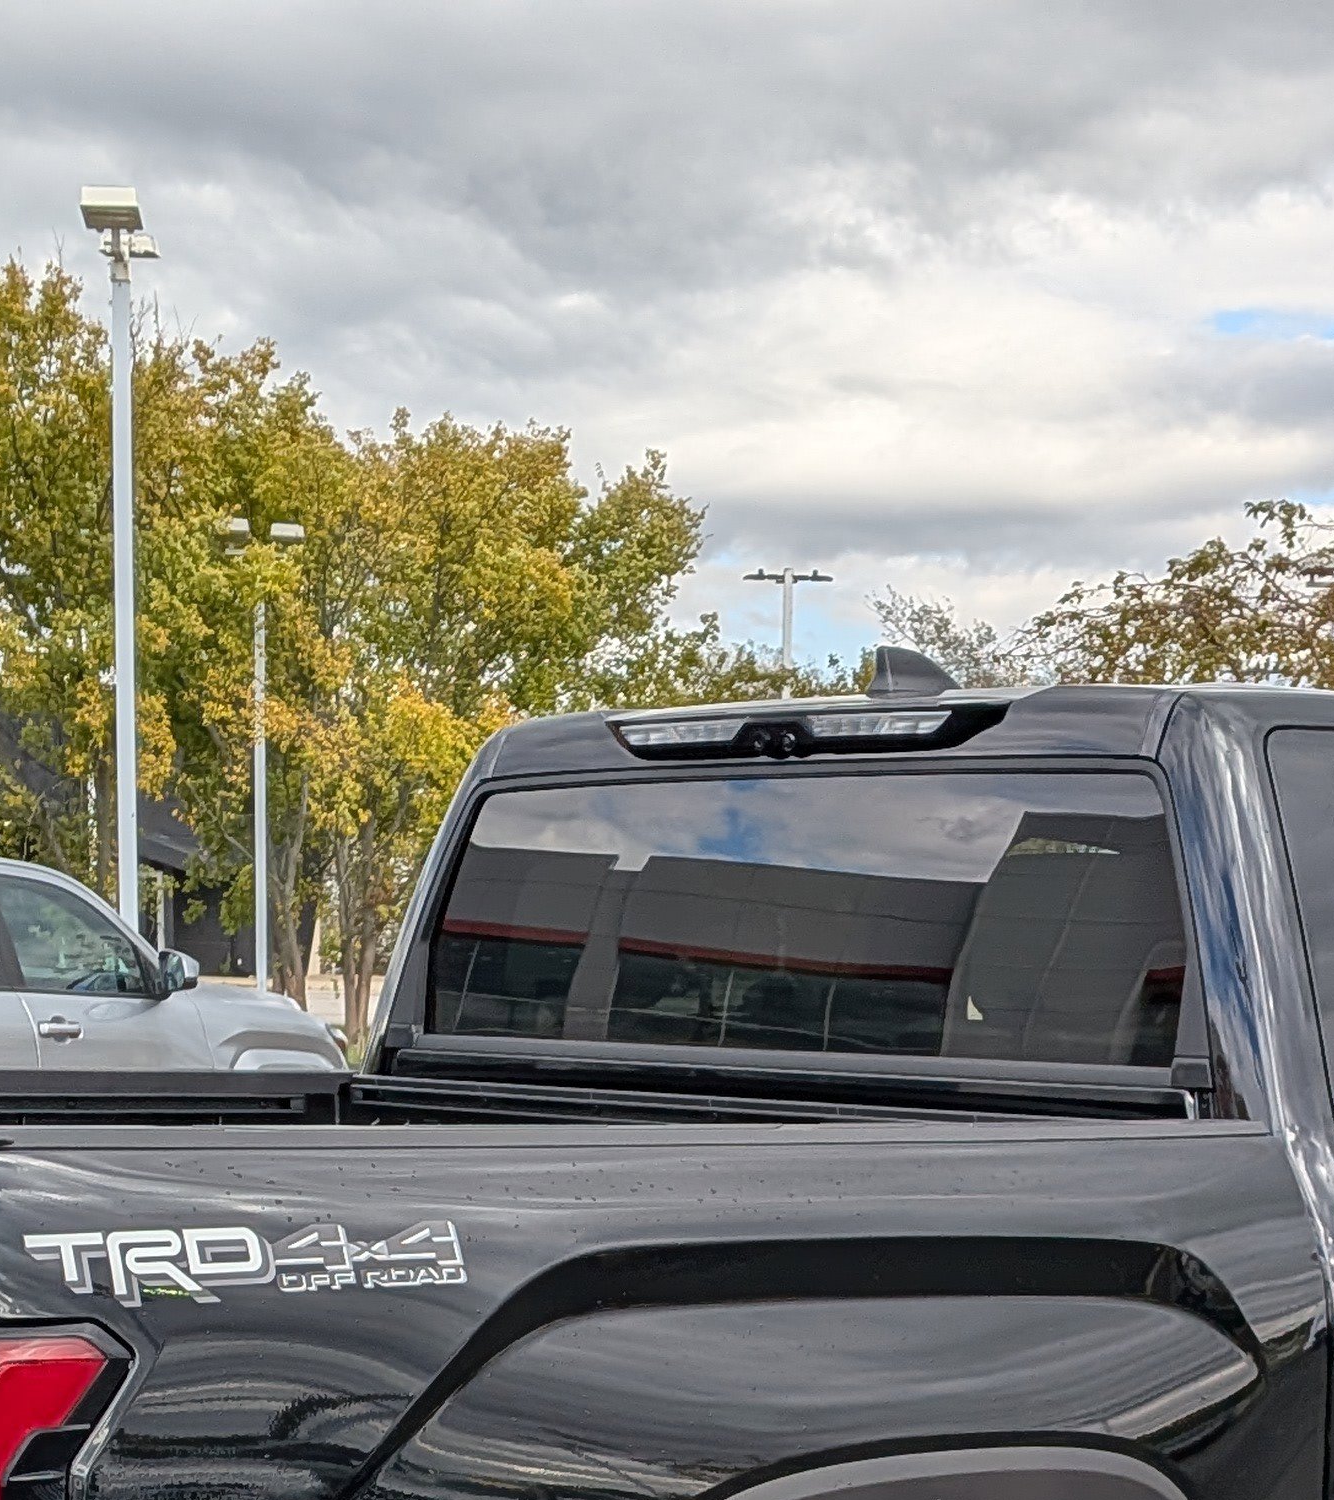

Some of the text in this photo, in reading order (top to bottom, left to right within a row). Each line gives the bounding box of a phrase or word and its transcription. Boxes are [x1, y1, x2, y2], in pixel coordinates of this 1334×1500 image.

[23, 1220, 464, 1308] TRD 4x4
[278, 1265, 468, 1292] OFF ROAD
